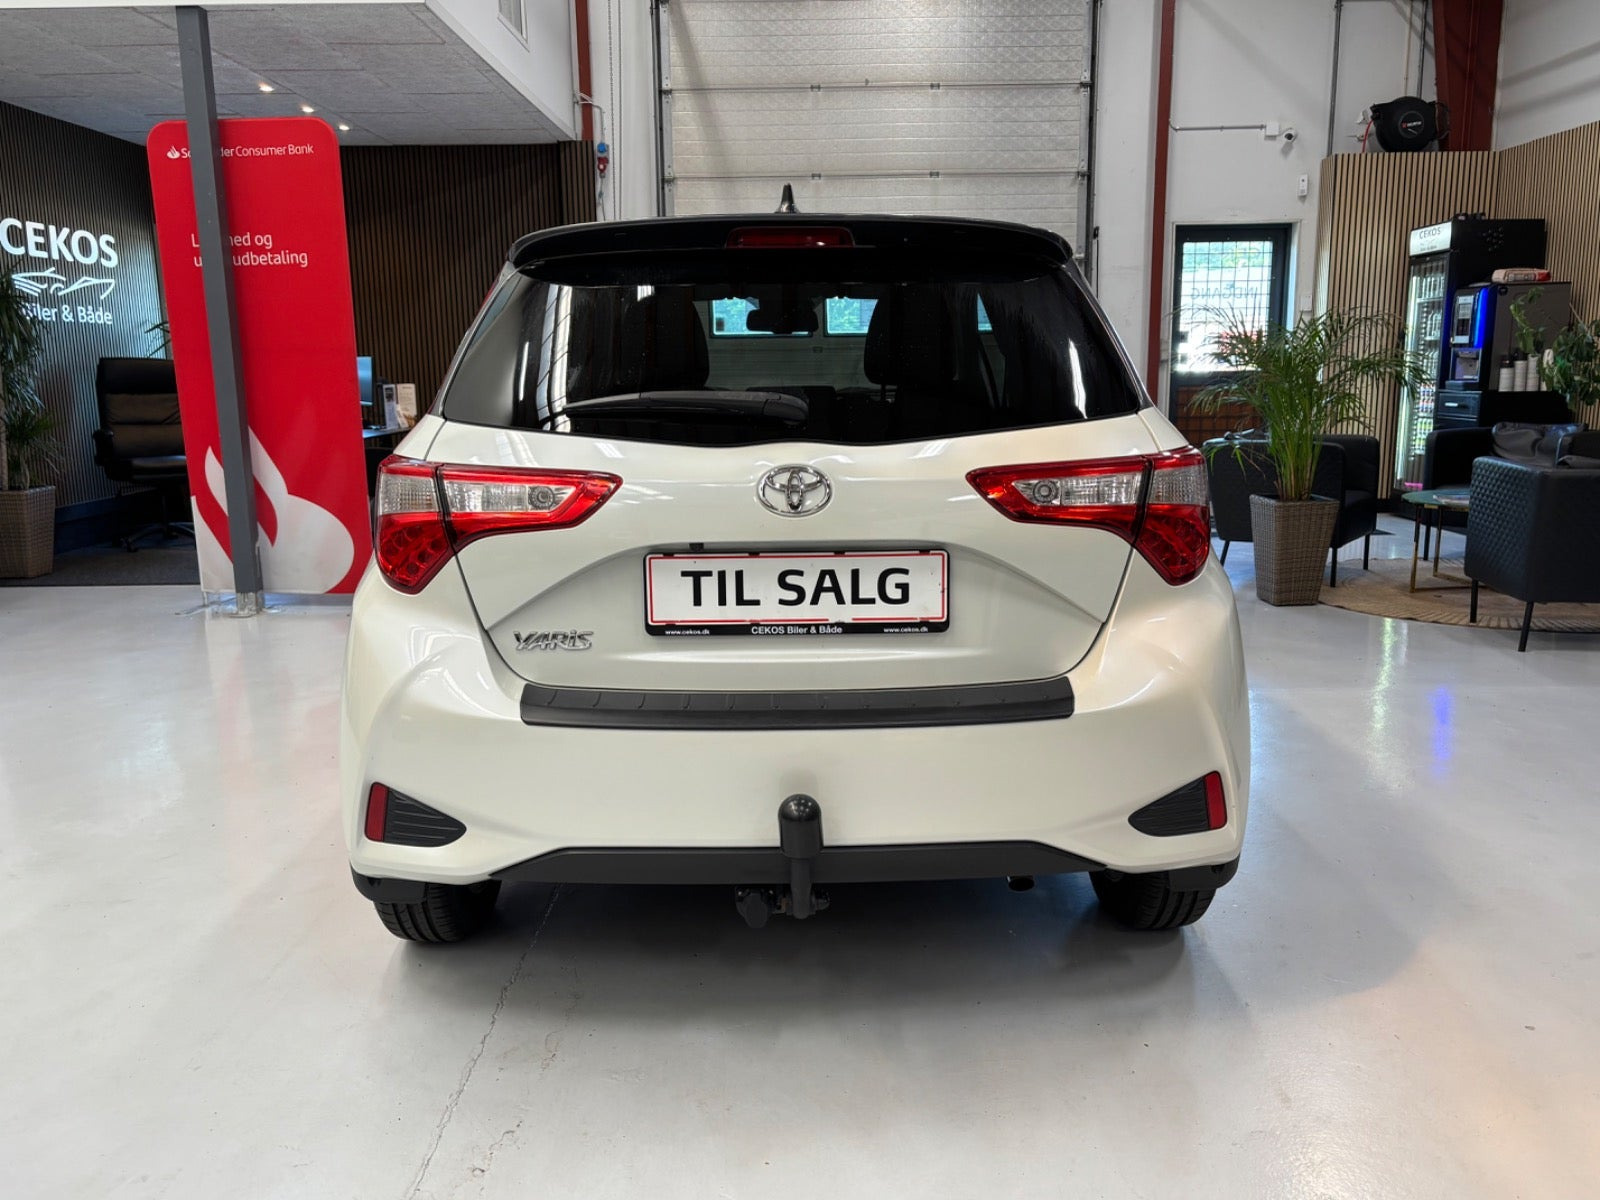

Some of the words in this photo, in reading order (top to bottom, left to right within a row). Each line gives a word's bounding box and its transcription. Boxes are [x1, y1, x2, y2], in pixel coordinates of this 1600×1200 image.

[235, 145, 286, 158] Consumer
[288, 143, 314, 155] Bank
[1419, 226, 1441, 240] CEKOS
[0, 217, 118, 268] CEKOS
[254, 234, 273, 249] og
[233, 250, 308, 267] udbetaling
[62, 304, 74, 322] &
[77, 305, 113, 324] Både
[680, 569, 761, 607] TIL
[777, 567, 910, 606] SALG
[665, 628, 710, 636] www.cekos.dk
[751, 625, 785, 635] CEKOS
[787, 625, 808, 634] Biler
[809, 625, 817, 634] &
[819, 624, 843, 634] Både
[883, 626, 928, 634] www.cekos.dk
